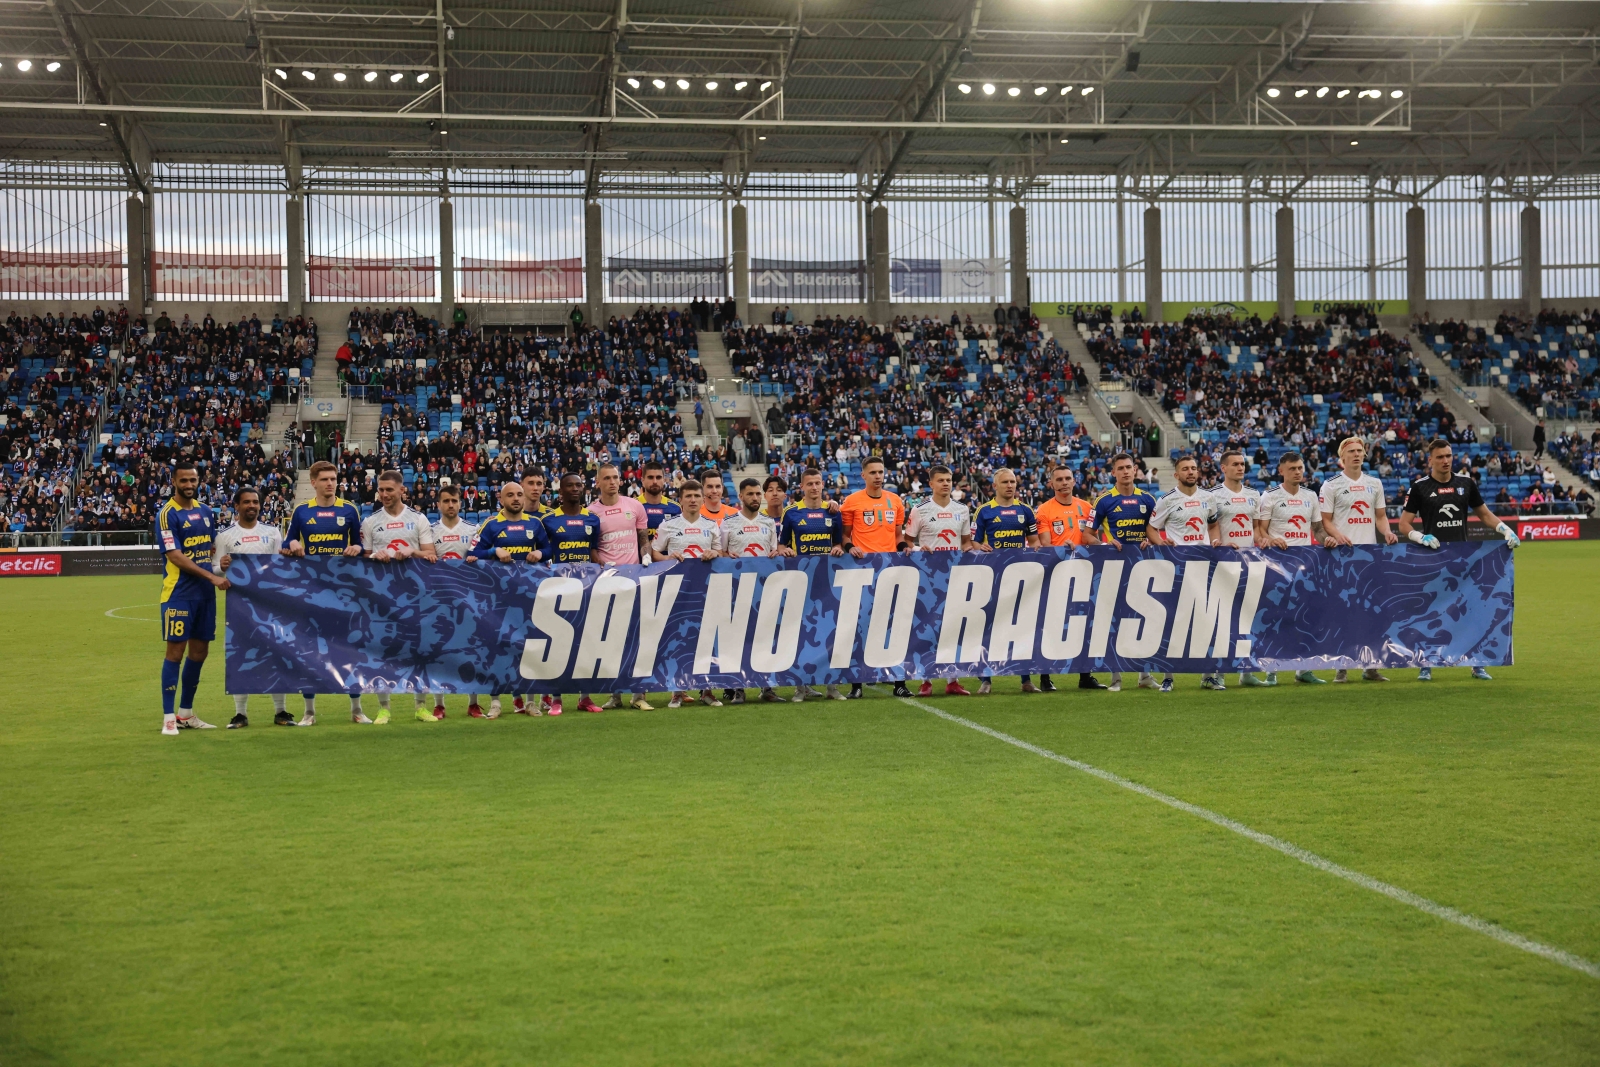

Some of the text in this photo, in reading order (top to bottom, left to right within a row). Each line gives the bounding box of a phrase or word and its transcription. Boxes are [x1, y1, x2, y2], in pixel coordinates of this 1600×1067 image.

[1106, 395, 1120, 404] C5
[317, 402, 333, 411] C3
[721, 400, 736, 409] C4
[1347, 517, 1372, 525] ORLEN
[1436, 520, 1463, 528] ORLEN
[1228, 530, 1252, 538] ORLEN
[318, 546, 343, 555] Energa
[809, 545, 832, 553] Energa
[0, 558, 56, 571] etclic
[519, 559, 1266, 680] SAY NO TO RACISM!
[169, 621, 185, 636] 18
